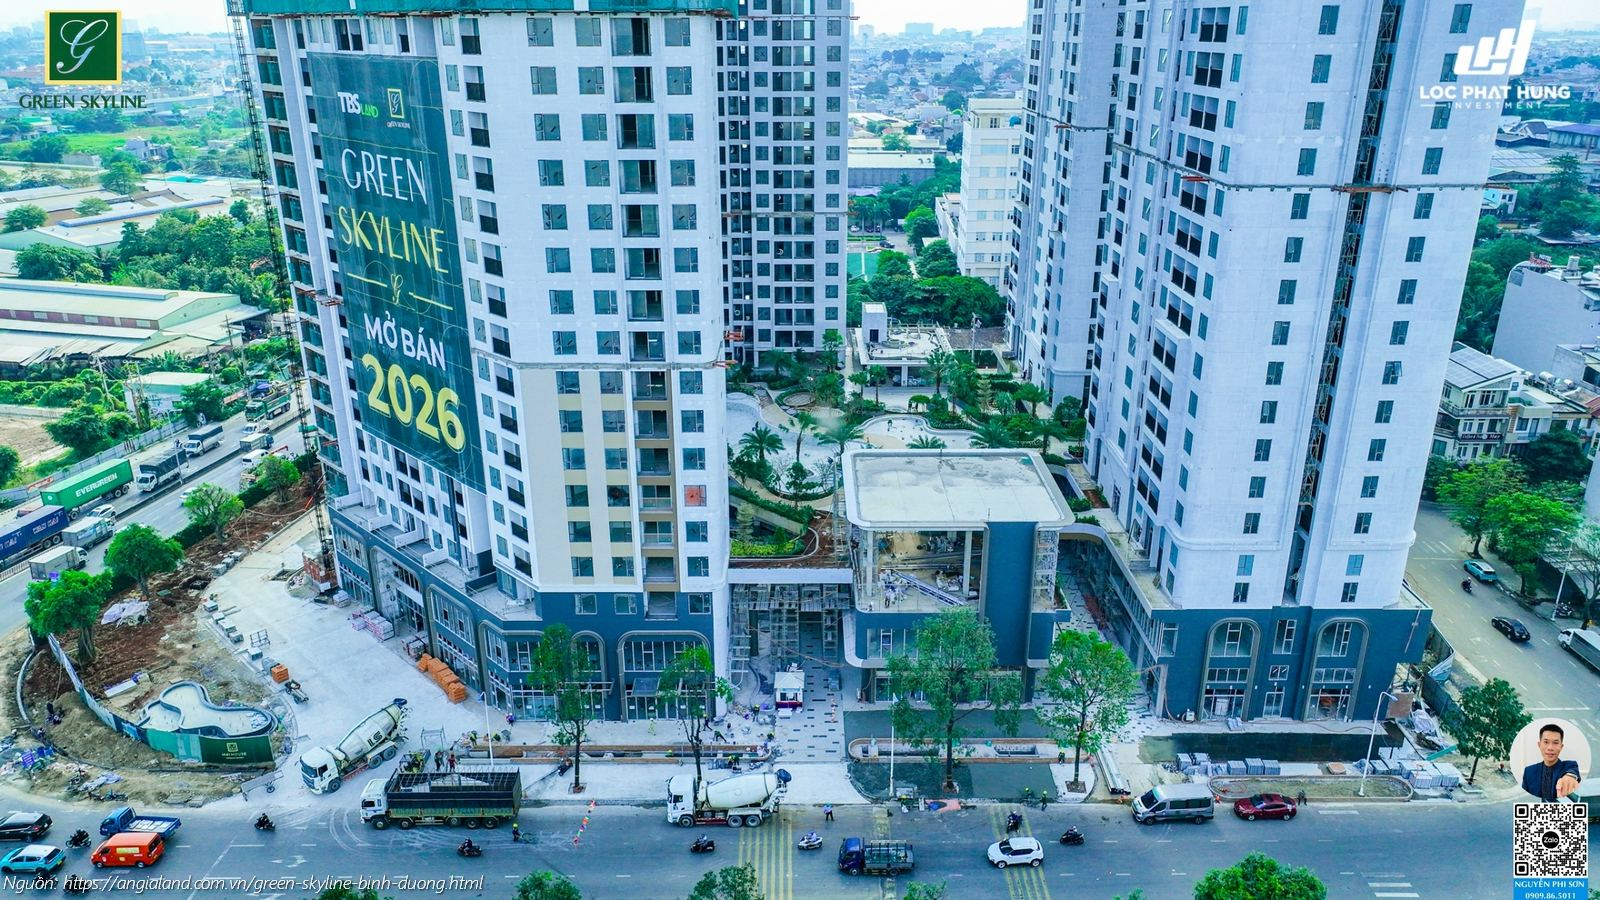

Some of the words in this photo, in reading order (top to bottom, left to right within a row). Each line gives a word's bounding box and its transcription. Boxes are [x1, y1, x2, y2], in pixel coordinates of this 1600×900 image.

[337, 91, 361, 115] TBS
[341, 148, 427, 204] GREEN
[338, 205, 449, 273] SKYLINE
[364, 311, 398, 349] MỞ
[401, 327, 446, 371] BÁN
[361, 353, 466, 454] 2026
[75, 473, 118, 497] EVERGREEN
